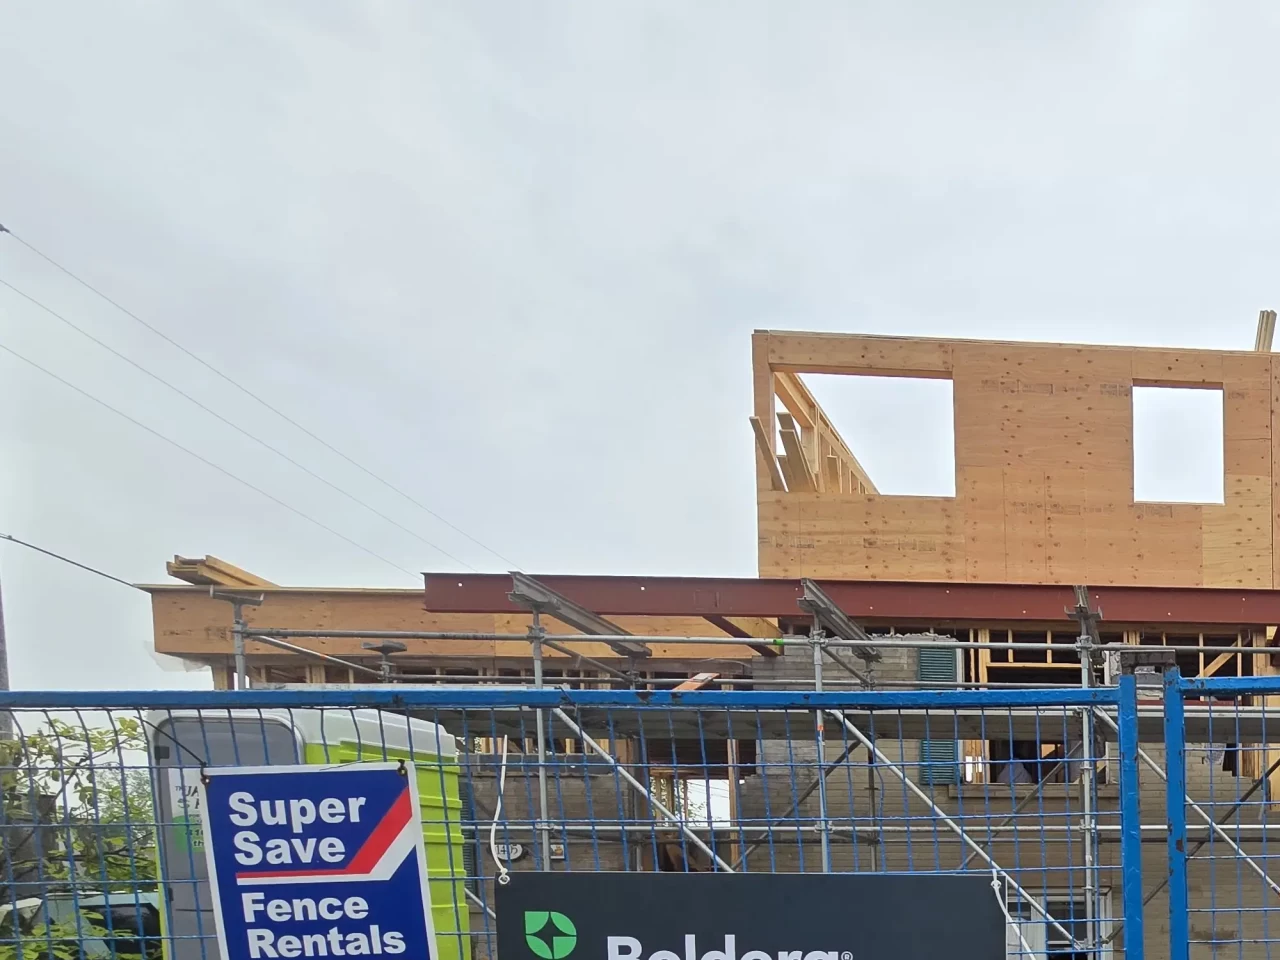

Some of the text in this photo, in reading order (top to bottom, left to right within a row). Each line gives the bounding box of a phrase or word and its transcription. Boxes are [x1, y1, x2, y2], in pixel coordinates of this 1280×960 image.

[228, 791, 366, 833] Super
[233, 831, 346, 866] Save
[241, 892, 369, 922] Fence
[247, 924, 406, 958] Rentals
